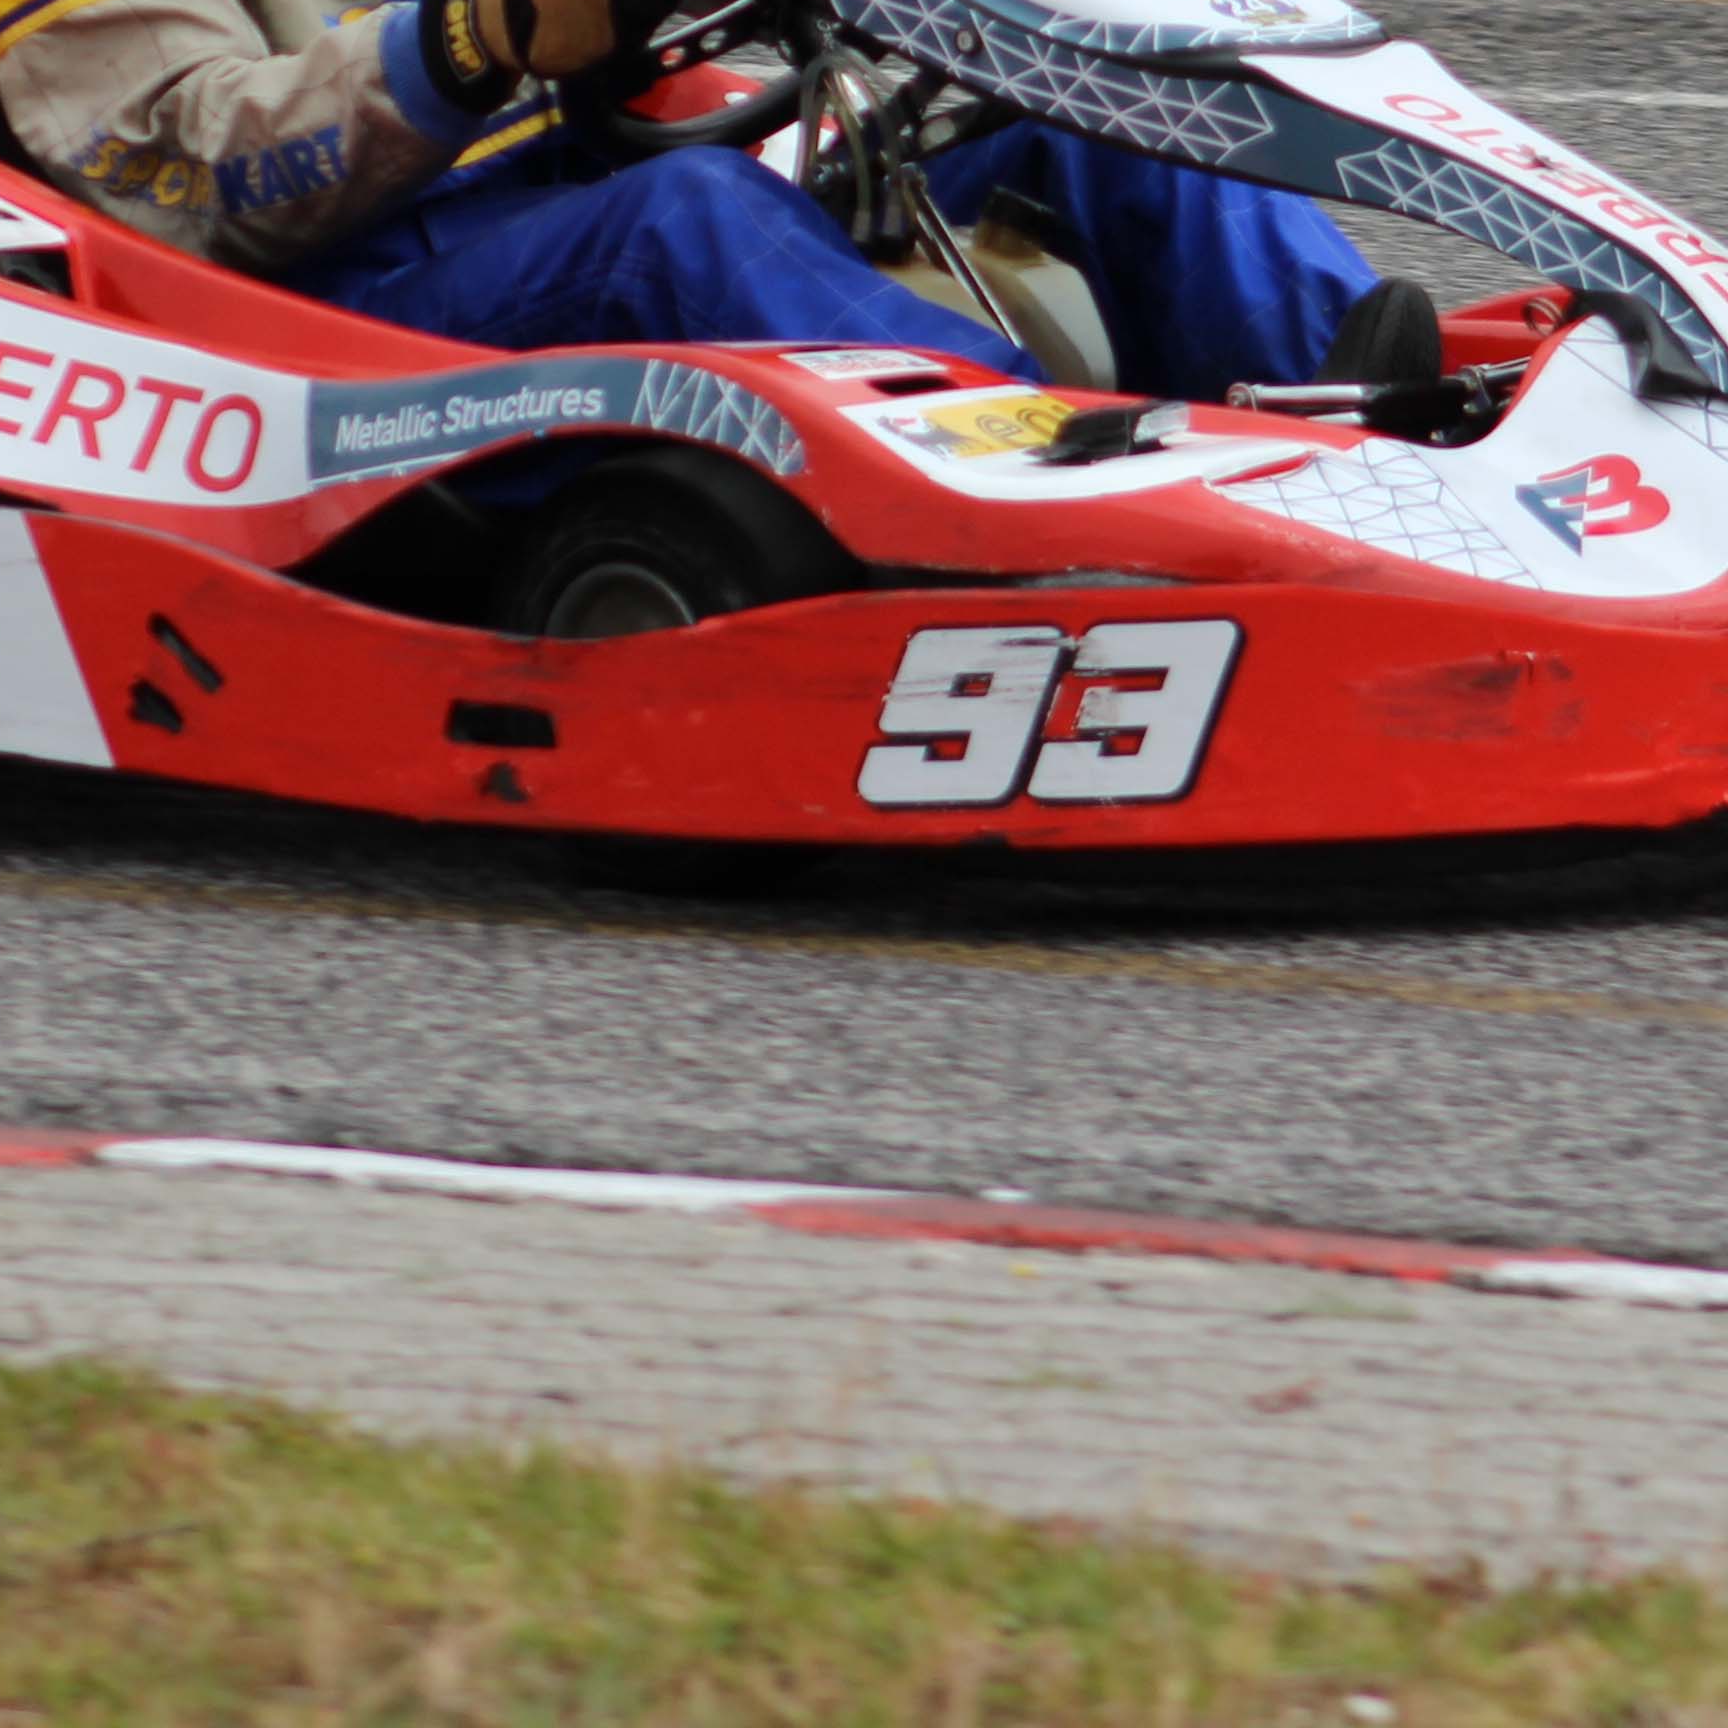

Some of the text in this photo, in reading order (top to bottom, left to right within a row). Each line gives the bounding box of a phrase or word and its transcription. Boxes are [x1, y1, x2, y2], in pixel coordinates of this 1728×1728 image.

[215, 123, 348, 214] KART
[335, 386, 606, 453] Metallic Structures
[856, 619, 1243, 809] 93
